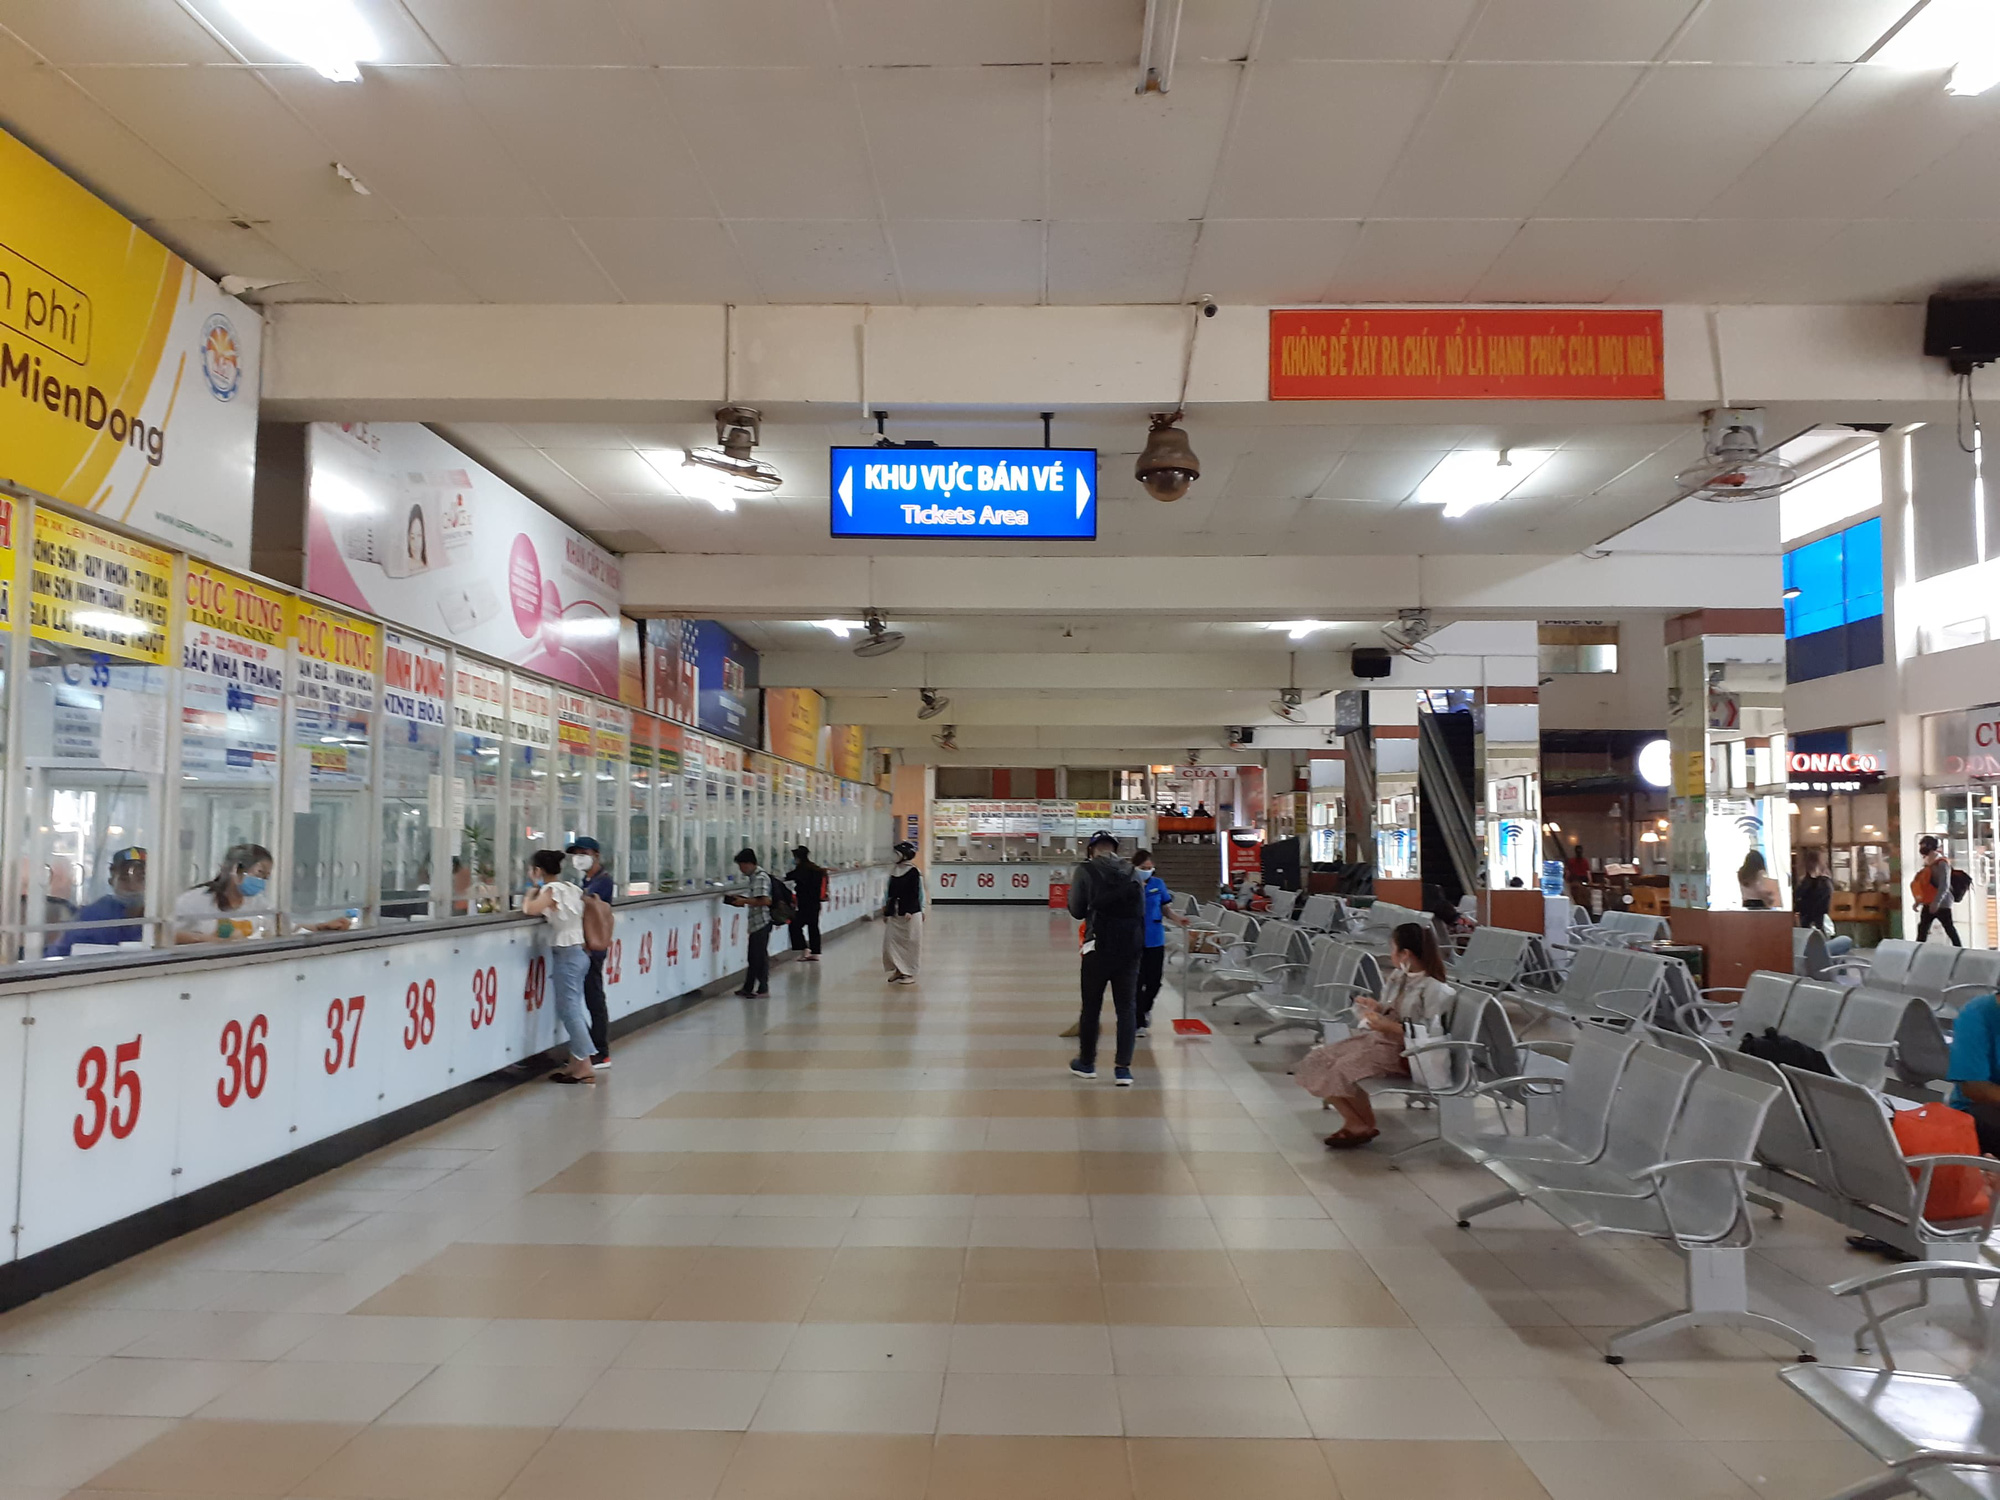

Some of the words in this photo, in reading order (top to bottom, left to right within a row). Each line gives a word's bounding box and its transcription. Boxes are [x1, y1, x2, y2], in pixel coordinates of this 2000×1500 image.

[25, 286, 81, 345] phí
[1281, 325, 1328, 377] KHÔNG
[1329, 317, 1352, 376] ĐỂ
[1352, 320, 1379, 376] XẢY
[1381, 334, 1399, 376] RA
[1403, 326, 1442, 384] CHÁY,
[1445, 316, 1467, 376] NỔ
[1467, 325, 1485, 376] LÀ
[1488, 334, 1526, 384] HẠNH
[1529, 326, 1567, 376] PHÚC
[1568, 320, 1596, 376] CỦA
[1598, 334, 1624, 384] MỌI
[1625, 325, 1655, 376] NHÀ
[1, 342, 164, 467] MienDong
[864, 463, 918, 490] KHU
[920, 461, 973, 498] VỰC
[976, 460, 1029, 491] BÁN
[1031, 460, 1064, 491] VÉ
[900, 503, 976, 525] Tickets
[978, 505, 1029, 525] Area
[186, 569, 227, 614] CÚC
[233, 584, 283, 633] TÙNG
[191, 607, 277, 646] LIMOUSINE
[1975, 722, 2000, 747] C
[1182, 767, 1217, 778] CỬA
[1114, 804, 1125, 814] AN
[1127, 804, 1148, 814] SINH
[940, 873, 958, 888] 67
[977, 873, 995, 888] 68
[1011, 873, 1029, 888] 69
[606, 938, 622, 985] 42
[638, 931, 653, 974] 43
[666, 927, 679, 966] 44
[470, 965, 498, 1030] 39
[524, 955, 546, 1012] 40
[324, 995, 366, 1075] 37
[403, 978, 437, 1051] 38
[217, 1013, 269, 1108] 36
[72, 1033, 143, 1150] 35
